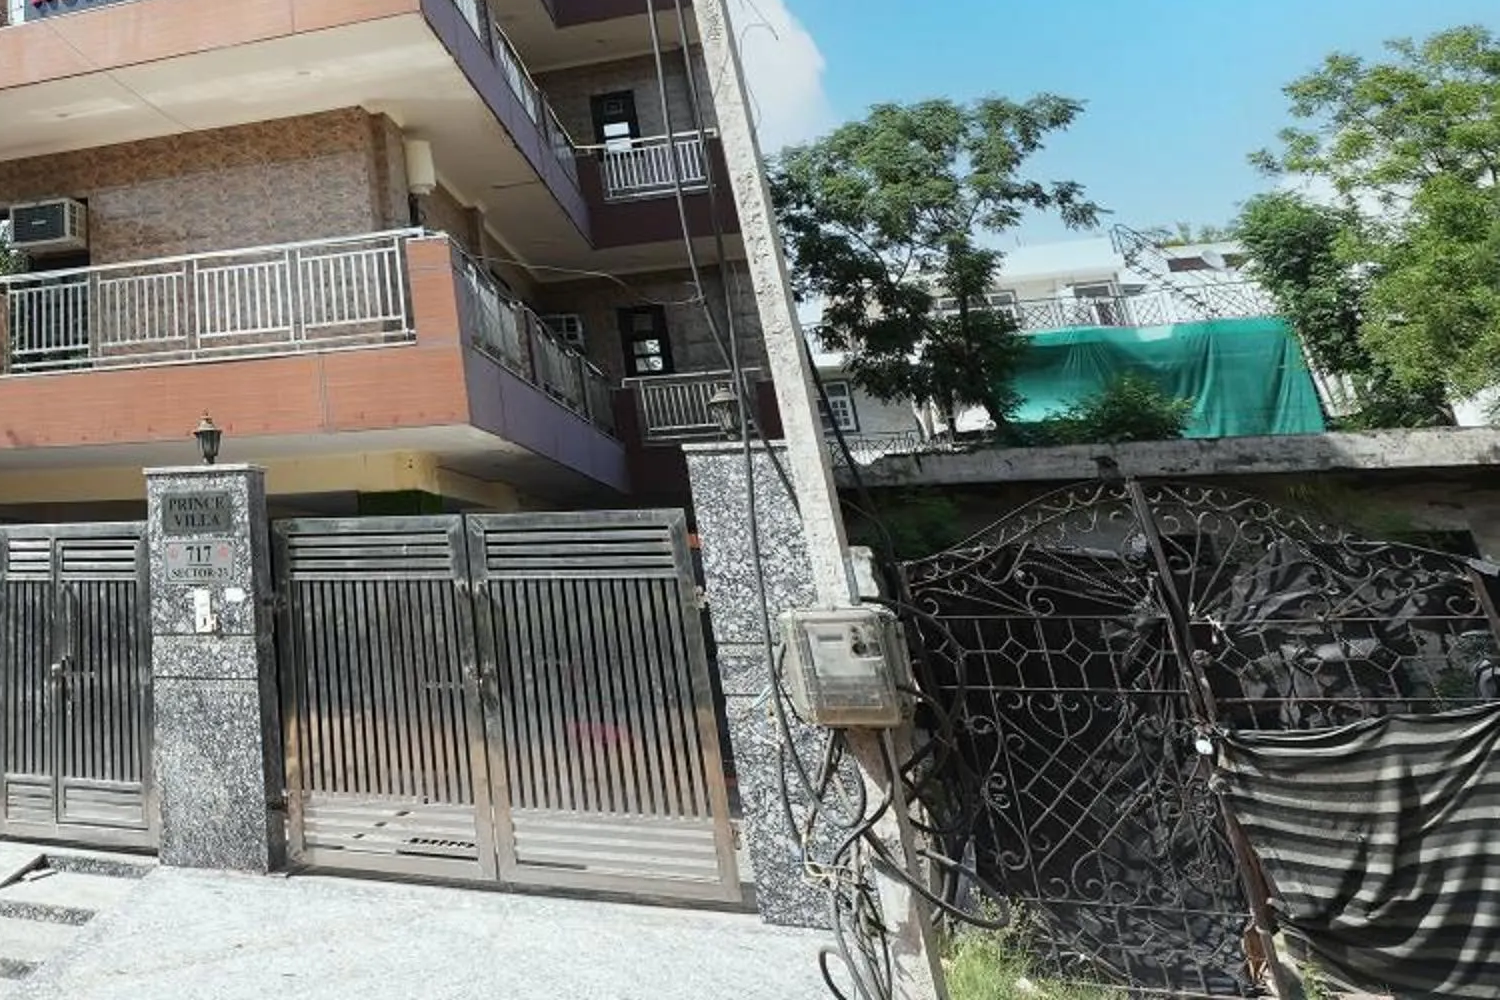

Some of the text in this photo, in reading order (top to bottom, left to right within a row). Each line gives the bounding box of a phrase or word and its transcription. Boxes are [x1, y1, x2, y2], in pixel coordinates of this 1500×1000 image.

[169, 497, 224, 511] PRINCE
[174, 513, 221, 527] VILLA
[186, 545, 211, 562] 717
